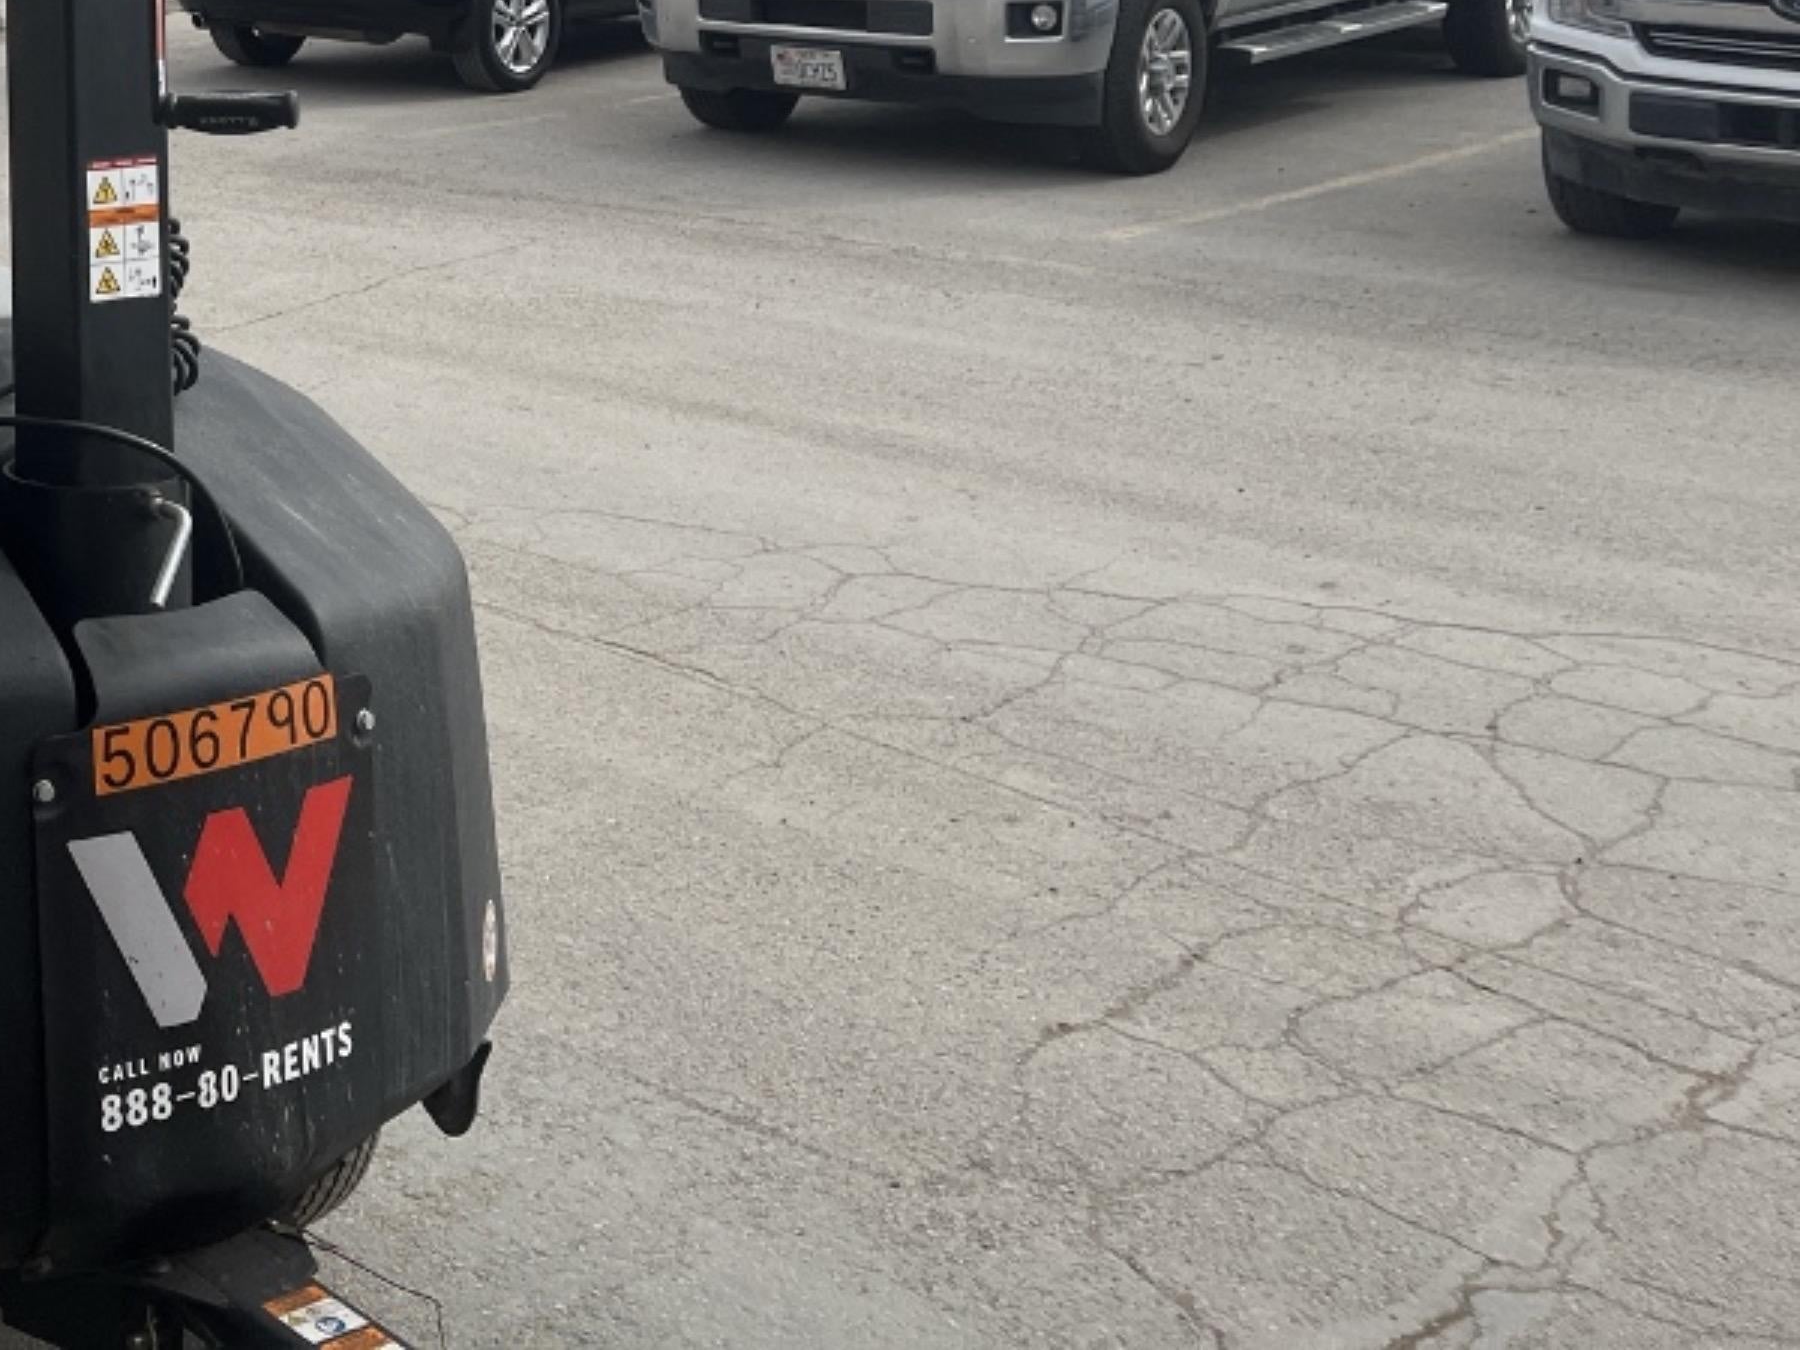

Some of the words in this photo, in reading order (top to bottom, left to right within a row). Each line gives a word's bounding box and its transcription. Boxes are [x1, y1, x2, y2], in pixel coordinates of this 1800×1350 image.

[102, 681, 331, 788] 506790
[98, 1059, 149, 1085] CALL
[159, 1044, 201, 1070] NOW
[101, 1021, 353, 1132] 888-80-RENTS
